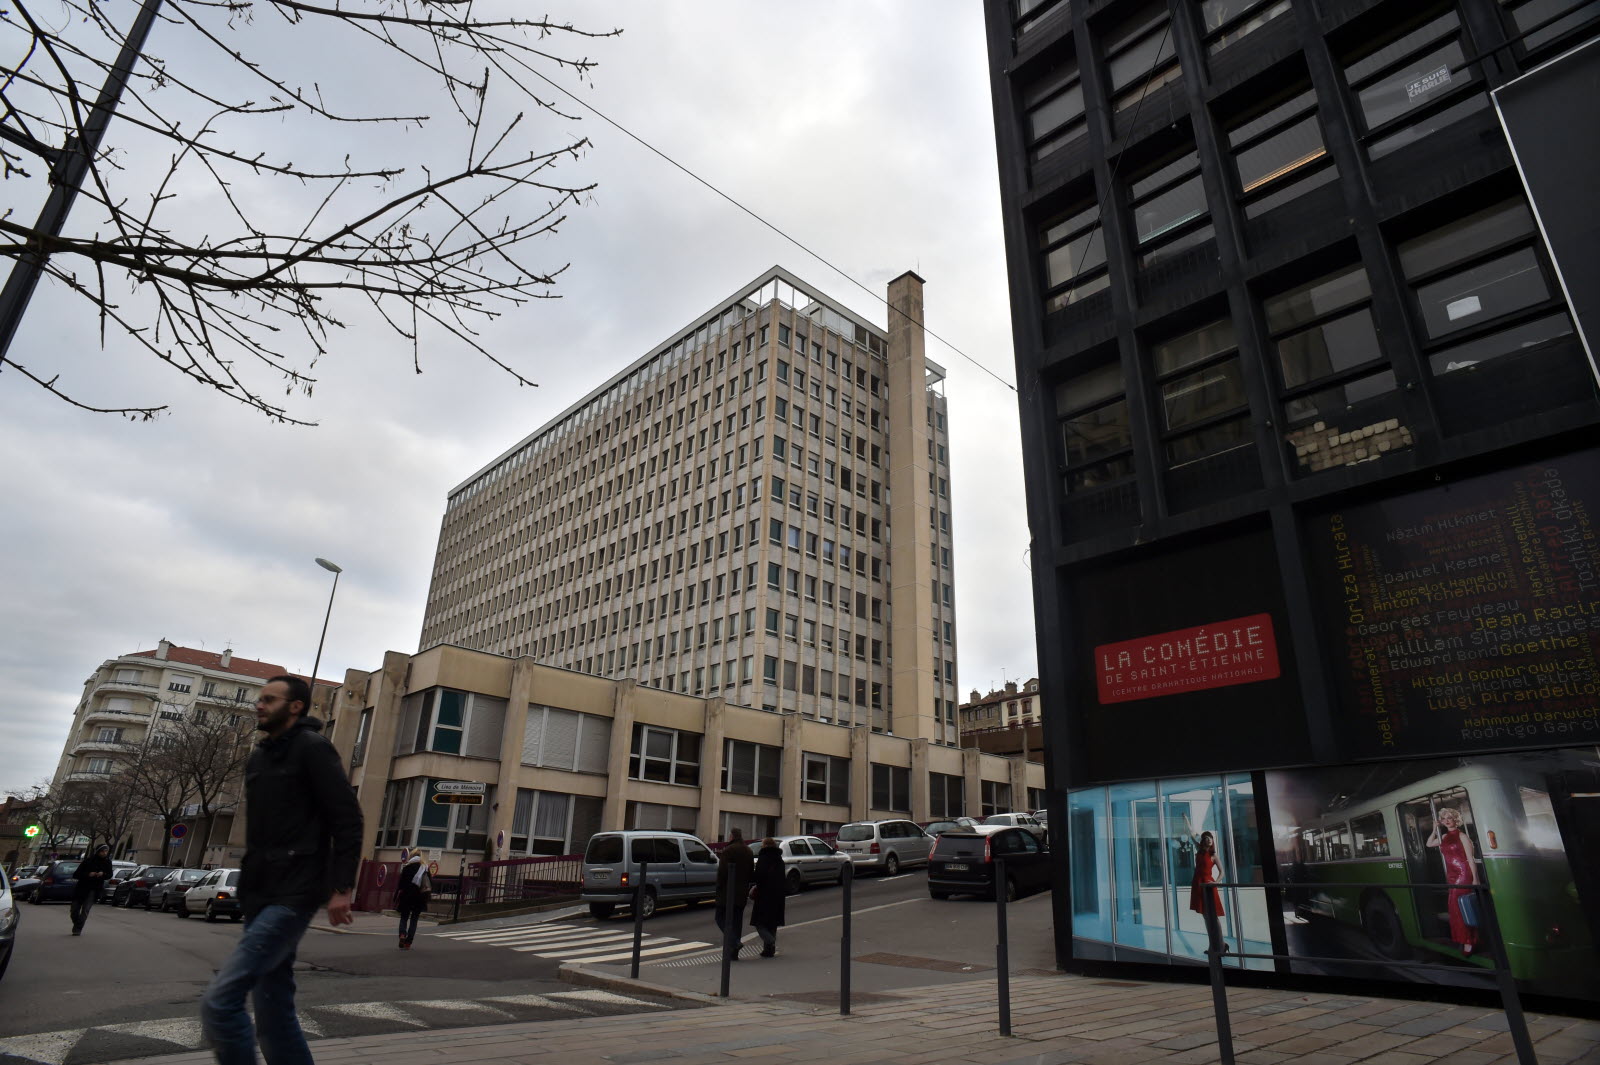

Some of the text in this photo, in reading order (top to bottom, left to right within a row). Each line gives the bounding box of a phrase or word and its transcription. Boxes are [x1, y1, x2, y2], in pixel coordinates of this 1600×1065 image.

[1409, 68, 1447, 92] JE SUIS
[1410, 73, 1450, 98] CHARLIE
[1437, 508, 1497, 531] Hikmet
[1544, 468, 1597, 593] Toshiki Okada
[1329, 513, 1353, 571] Hirata
[1505, 504, 1546, 598] Mark Ravenhill
[1384, 562, 1440, 584] Daniel
[1445, 553, 1501, 573] Keene
[1343, 574, 1364, 625] Oriza
[1373, 597, 1420, 613] Anton
[1424, 580, 1509, 604] Tchekhov
[1388, 571, 1507, 601] Lancelot Hamelin
[1359, 613, 1431, 636] Georges
[1436, 599, 1520, 622] Feydeau
[1473, 612, 1528, 632] Jean
[1104, 625, 1263, 671] LA COMÉDIE
[1387, 635, 1465, 658] William
[1391, 650, 1452, 671] Edward
[1457, 644, 1499, 661] Bond
[1500, 635, 1580, 656] Goethe
[1106, 648, 1265, 685] DE SAINT-ÉTIENNE
[1112, 666, 1264, 697] (CENTRE DRAMATIQUE NATIONAL)
[1364, 647, 1387, 714] Pommerat
[1411, 671, 1463, 689] Witold
[1468, 658, 1590, 682] Gombrowicz
[1426, 673, 1532, 697] Jean-Michel
[1428, 695, 1477, 711] Luigi
[1481, 681, 1597, 705] Pirandello
[1461, 723, 1537, 740] Rodrigo
[1464, 711, 1530, 729] Mahmoud
